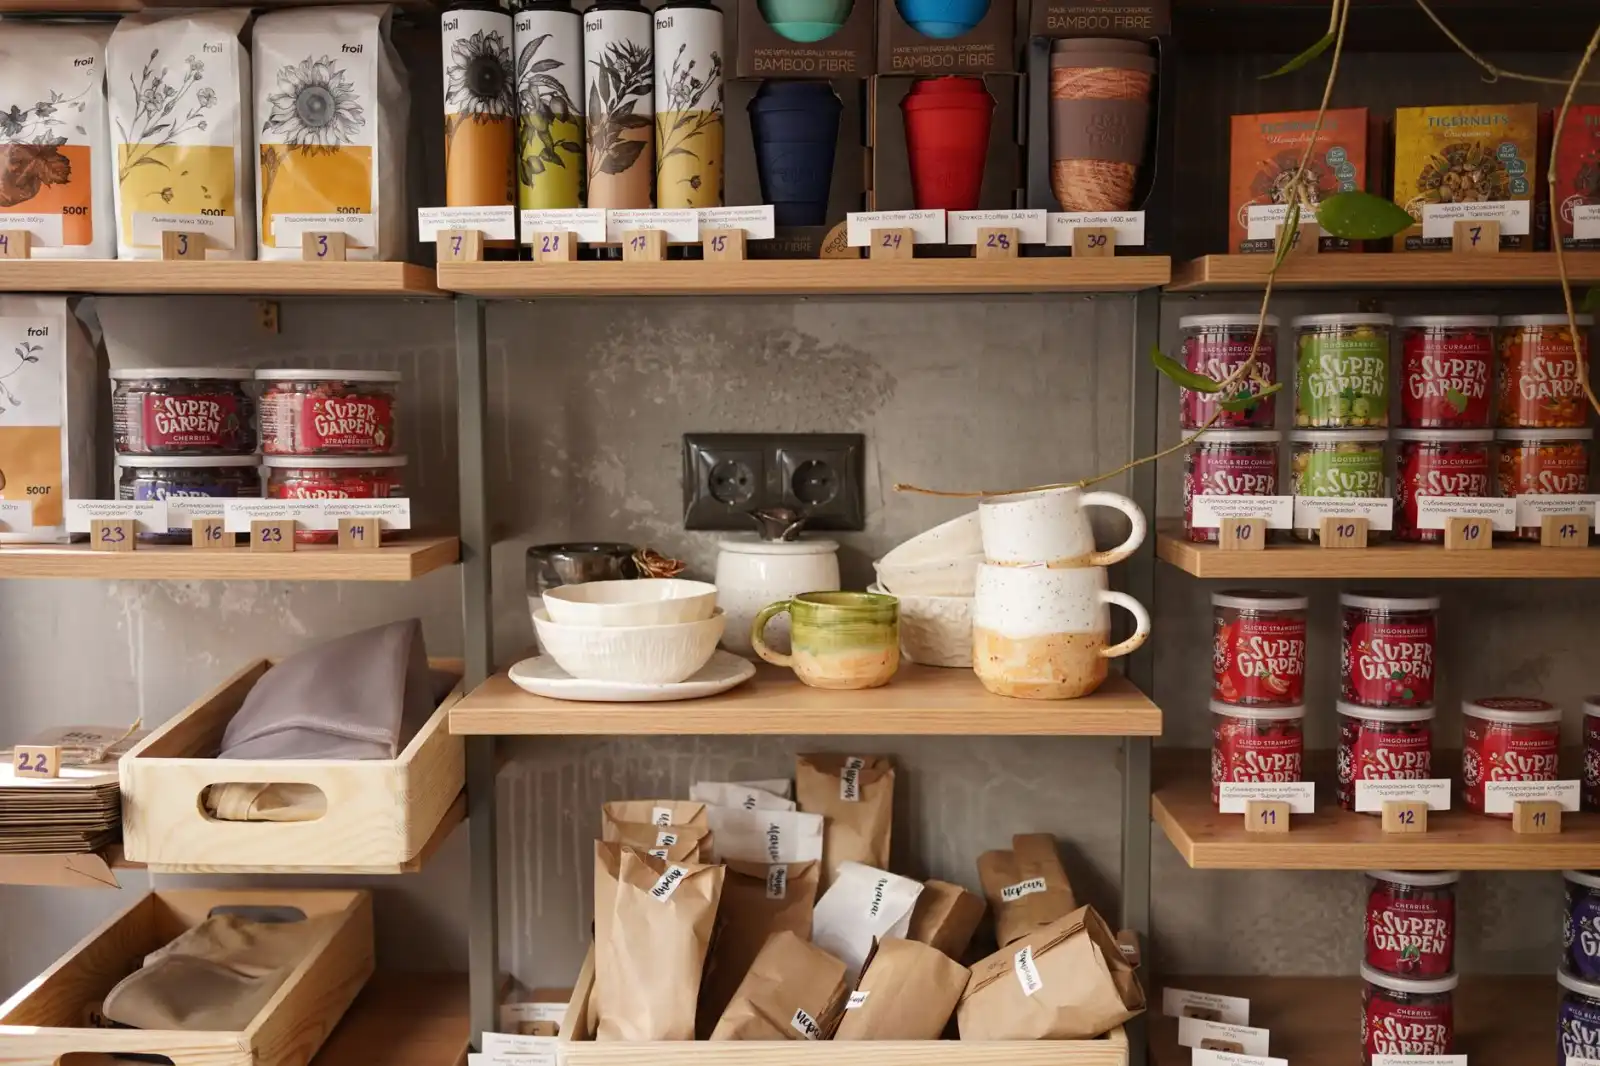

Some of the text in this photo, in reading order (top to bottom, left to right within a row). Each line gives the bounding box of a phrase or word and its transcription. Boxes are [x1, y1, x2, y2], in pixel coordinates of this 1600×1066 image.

[443, 18, 458, 31] froil
[515, 19, 531, 32] froil
[585, 19, 603, 32] froil
[656, 17, 674, 30] froil
[1047, 16, 1152, 29] BAMBOO FIBRE
[202, 43, 223, 53] froil
[341, 43, 363, 54] froil
[73, 57, 94, 67] froil
[754, 58, 856, 72] BAMBOO FIBRE
[893, 53, 995, 69] BAMBOO FIBRE
[1428, 114, 1509, 128] TIGERNUTS
[857, 214, 880, 223] Кружка
[958, 214, 983, 223] Кружка
[1056, 216, 1081, 225] Кружка
[177, 233, 188, 255] 3
[541, 235, 560, 253] 28
[630, 235, 646, 252] 17
[711, 235, 728, 252] 15
[882, 234, 902, 249] 24
[986, 234, 1010, 249] 28
[1087, 234, 1107, 248] 30
[1469, 226, 1482, 247] 7
[316, 235, 328, 257] 3
[450, 235, 462, 256] 7
[27, 326, 49, 337] froil
[1320, 354, 1385, 382] SUPER
[1421, 355, 1487, 383] SUPER
[1308, 372, 1384, 399] GARDEN
[1409, 373, 1485, 400] GARDEN
[165, 397, 221, 422] SUPER
[325, 399, 376, 424] SUPER
[155, 412, 220, 434] GARDEN
[314, 414, 376, 437] GARDEN
[1214, 470, 1275, 496] SUPER
[1327, 468, 1384, 494] SUPER
[1427, 470, 1487, 495] SUPER
[1539, 470, 1586, 495] SUPE
[101, 526, 126, 543] 23
[204, 525, 222, 541] 16
[261, 527, 282, 542] 23
[349, 525, 365, 541] 14
[1235, 524, 1252, 540] 10
[1336, 523, 1355, 538] 10
[1462, 523, 1480, 541] 10
[1559, 523, 1578, 539] 17
[1250, 636, 1305, 661] SUPER
[1371, 638, 1433, 665] SUPER
[1237, 652, 1304, 678] GARDEN
[1359, 654, 1432, 680] GARDEN
[18, 752, 49, 774] 22
[1245, 750, 1301, 775] SUPER
[1376, 748, 1431, 772] SUPER
[1260, 809, 1276, 825] 11
[1398, 810, 1415, 825] 12
[1532, 811, 1546, 828] 11
[1003, 879, 1044, 898] Персик
[1395, 902, 1431, 910] CHERRIES
[1382, 910, 1448, 939] SUPER
[1373, 924, 1446, 954] GARDEN
[1396, 1008, 1432, 1016] CHERRIES
[1384, 1016, 1447, 1045] SUPER
[1373, 1029, 1447, 1055] GARDEN
